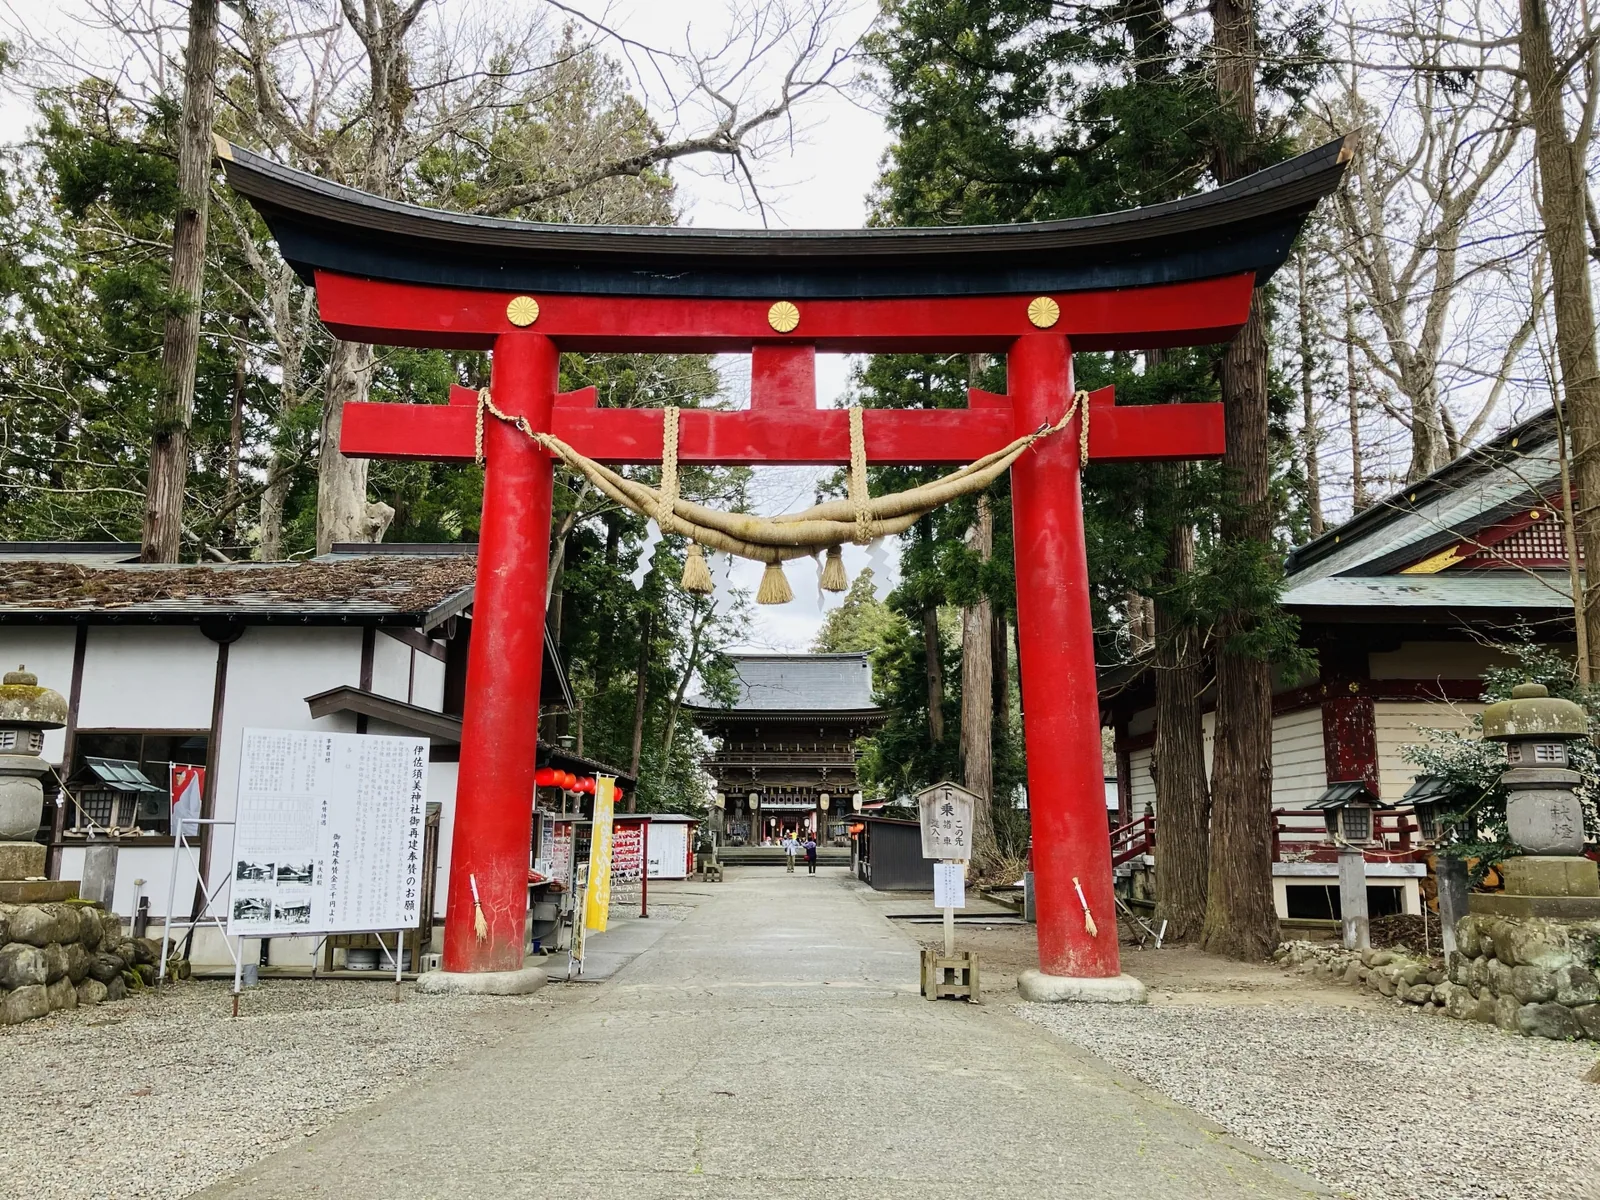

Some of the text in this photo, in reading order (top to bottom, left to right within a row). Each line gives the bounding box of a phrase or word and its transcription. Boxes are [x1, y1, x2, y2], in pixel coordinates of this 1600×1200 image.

[941, 788, 954, 816] 下乗
[404, 745, 425, 923] 伊佐須美神社御再建奉賛のお願い
[943, 820, 953, 846] 諸車
[954, 820, 964, 846] この先
[328, 833, 341, 925] 御再建奉賛金三千円より
